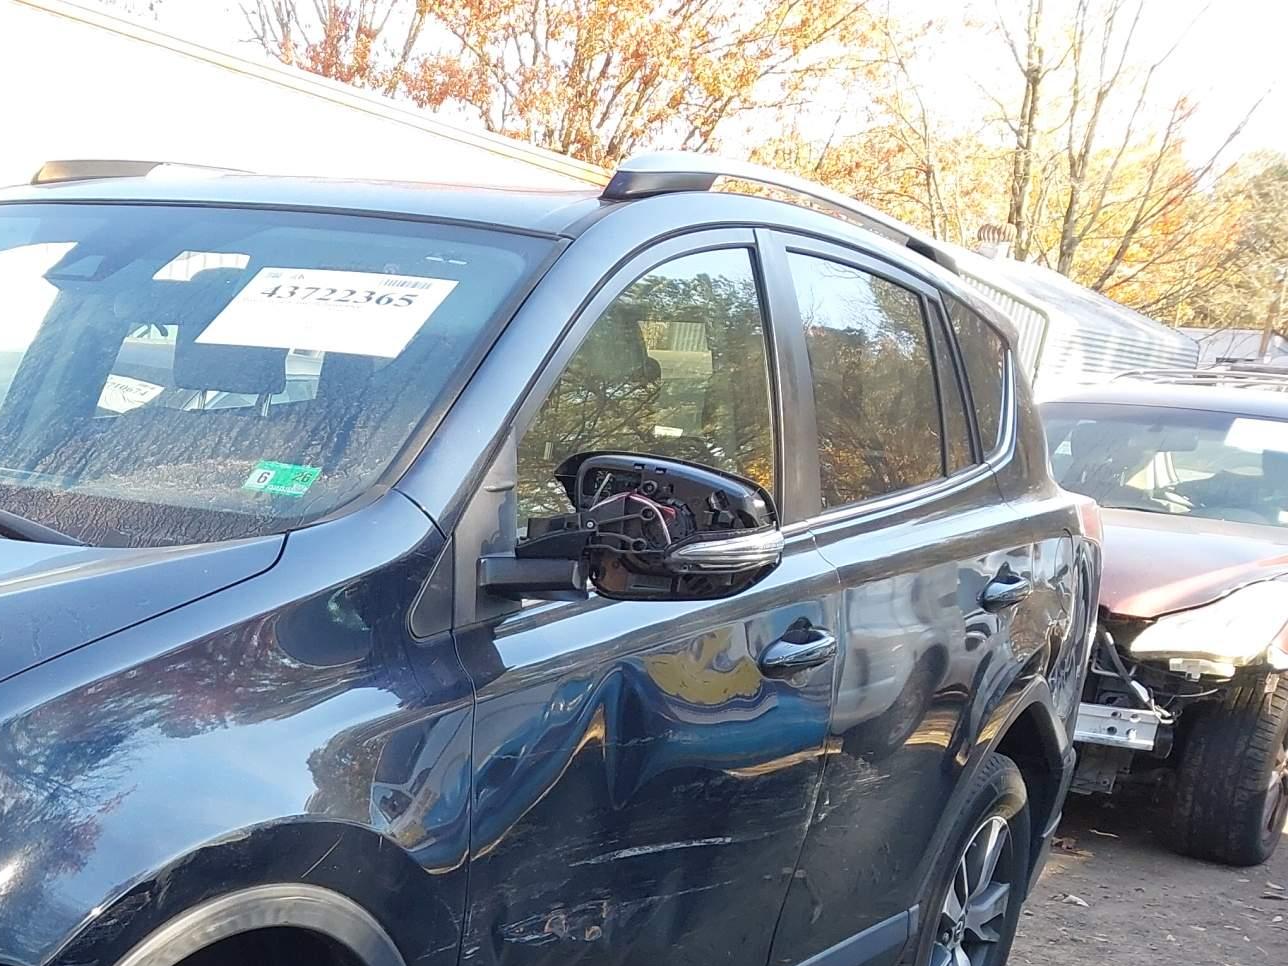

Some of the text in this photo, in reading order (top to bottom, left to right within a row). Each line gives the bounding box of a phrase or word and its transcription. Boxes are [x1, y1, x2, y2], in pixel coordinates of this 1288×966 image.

[260, 284, 419, 308] 43722365
[256, 471, 271, 484] 6
[292, 470, 313, 484] 26
